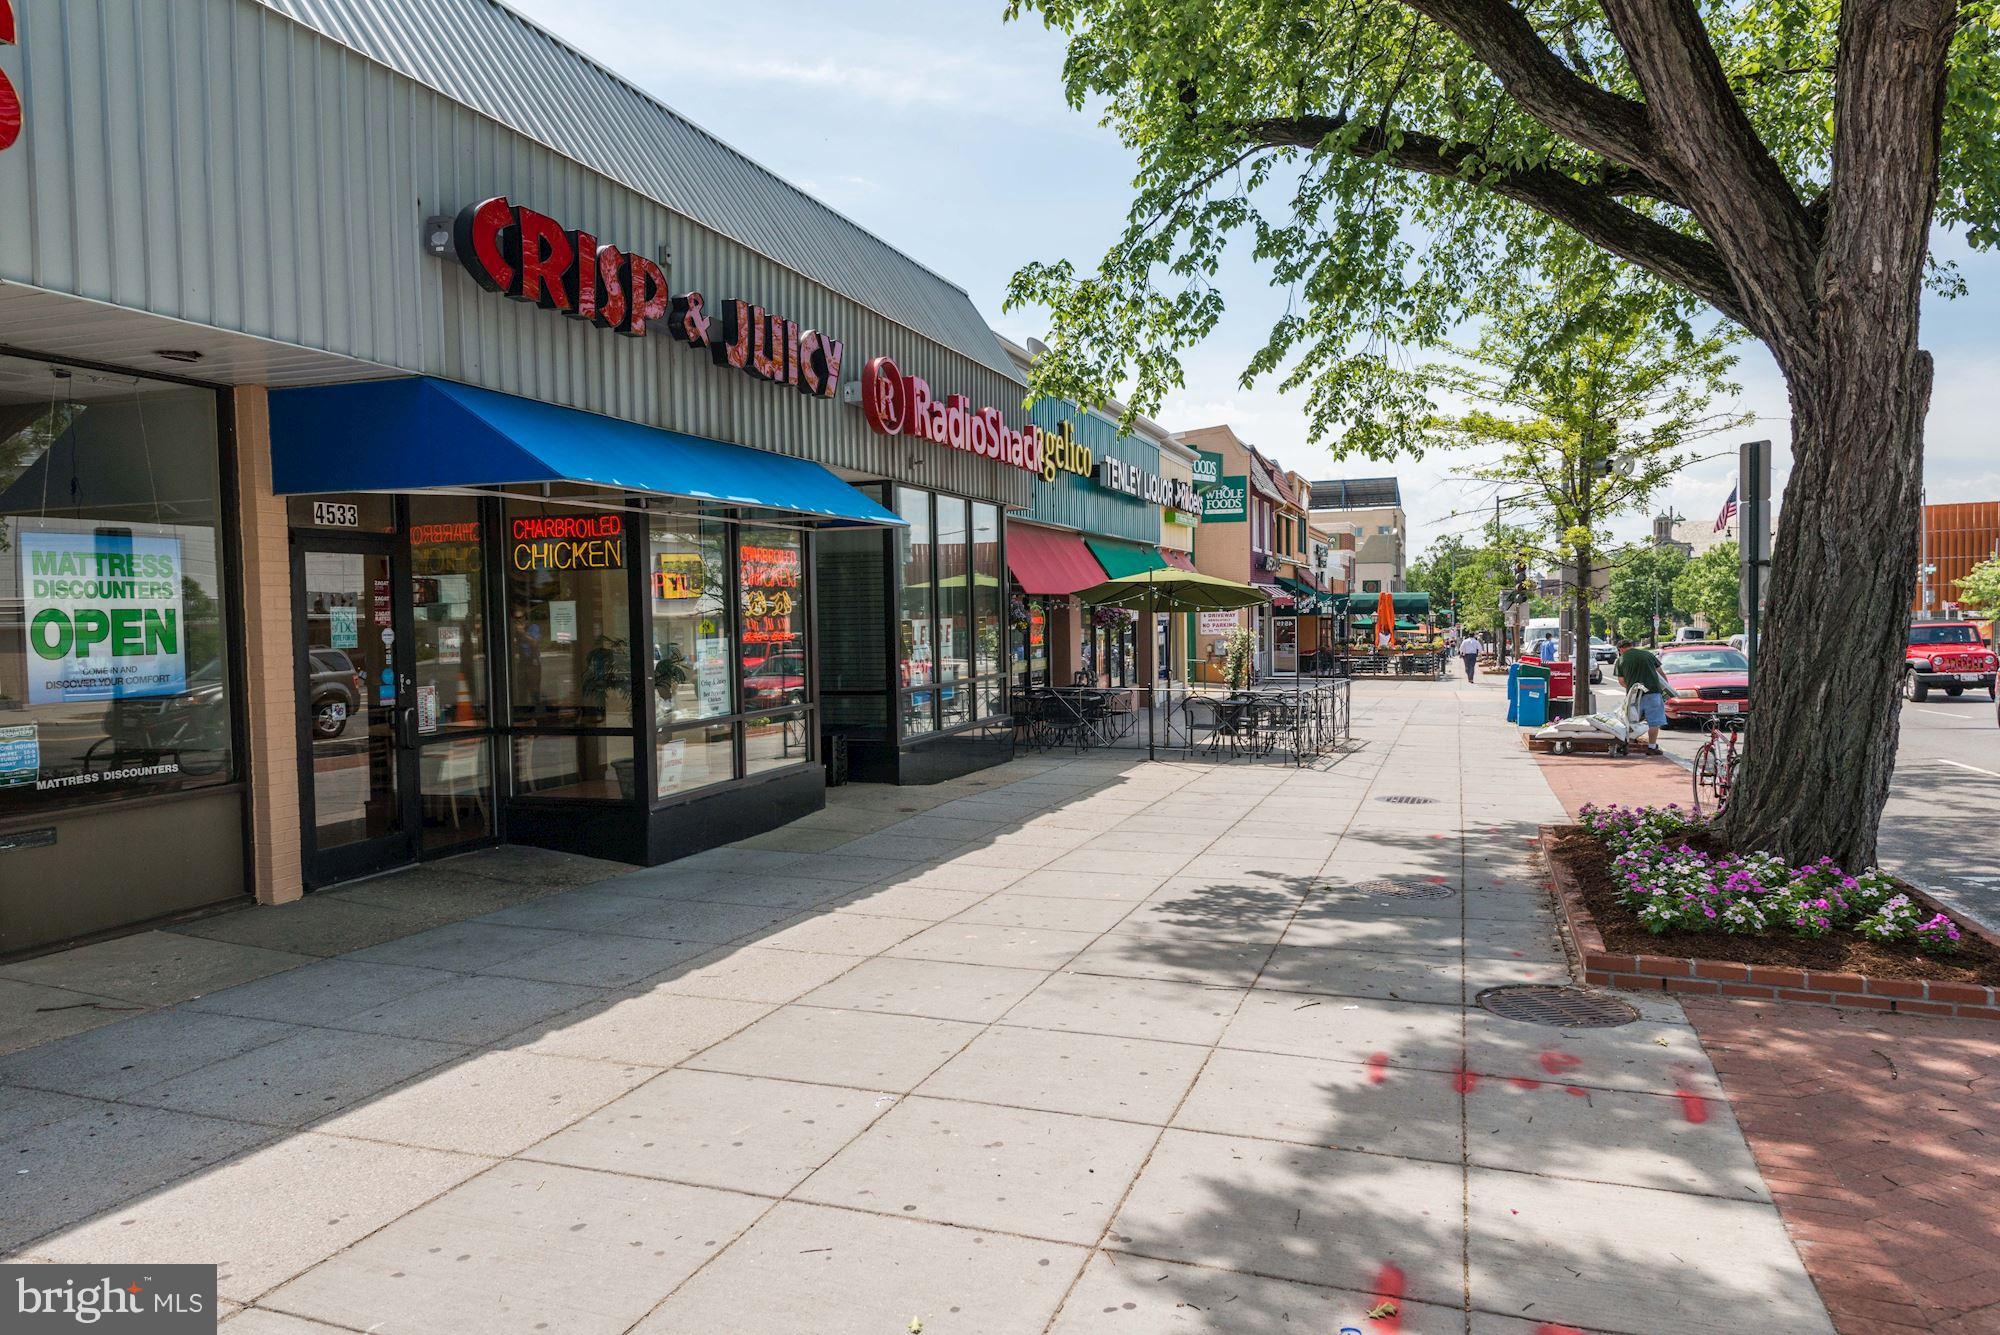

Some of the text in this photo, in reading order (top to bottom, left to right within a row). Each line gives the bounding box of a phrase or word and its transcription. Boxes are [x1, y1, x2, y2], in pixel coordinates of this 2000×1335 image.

[457, 196, 843, 399] CRISP & JUICY
[906, 376, 1043, 475] RadioShack
[1192, 459, 1217, 475] OODS
[1104, 454, 1142, 497] TENLEY
[1143, 471, 1174, 508] LIQUOR
[1206, 485, 1244, 499] WHOLE
[315, 503, 357, 525] 4533
[1206, 498, 1242, 509] FOODS
[513, 514, 622, 540] CHARBROILED
[32, 550, 173, 578] MATTRESS
[513, 540, 622, 571] CHICKEN
[33, 579, 174, 600] DISCOUNTERS
[332, 611, 355, 621] BEST
[30, 608, 178, 660] OPEN
[45, 674, 170, 690] DISCOVER YOUR COMFORT
[82, 666, 138, 675] COME IN AND
[36, 763, 179, 791] MATTRESS DISCOUNTERS
